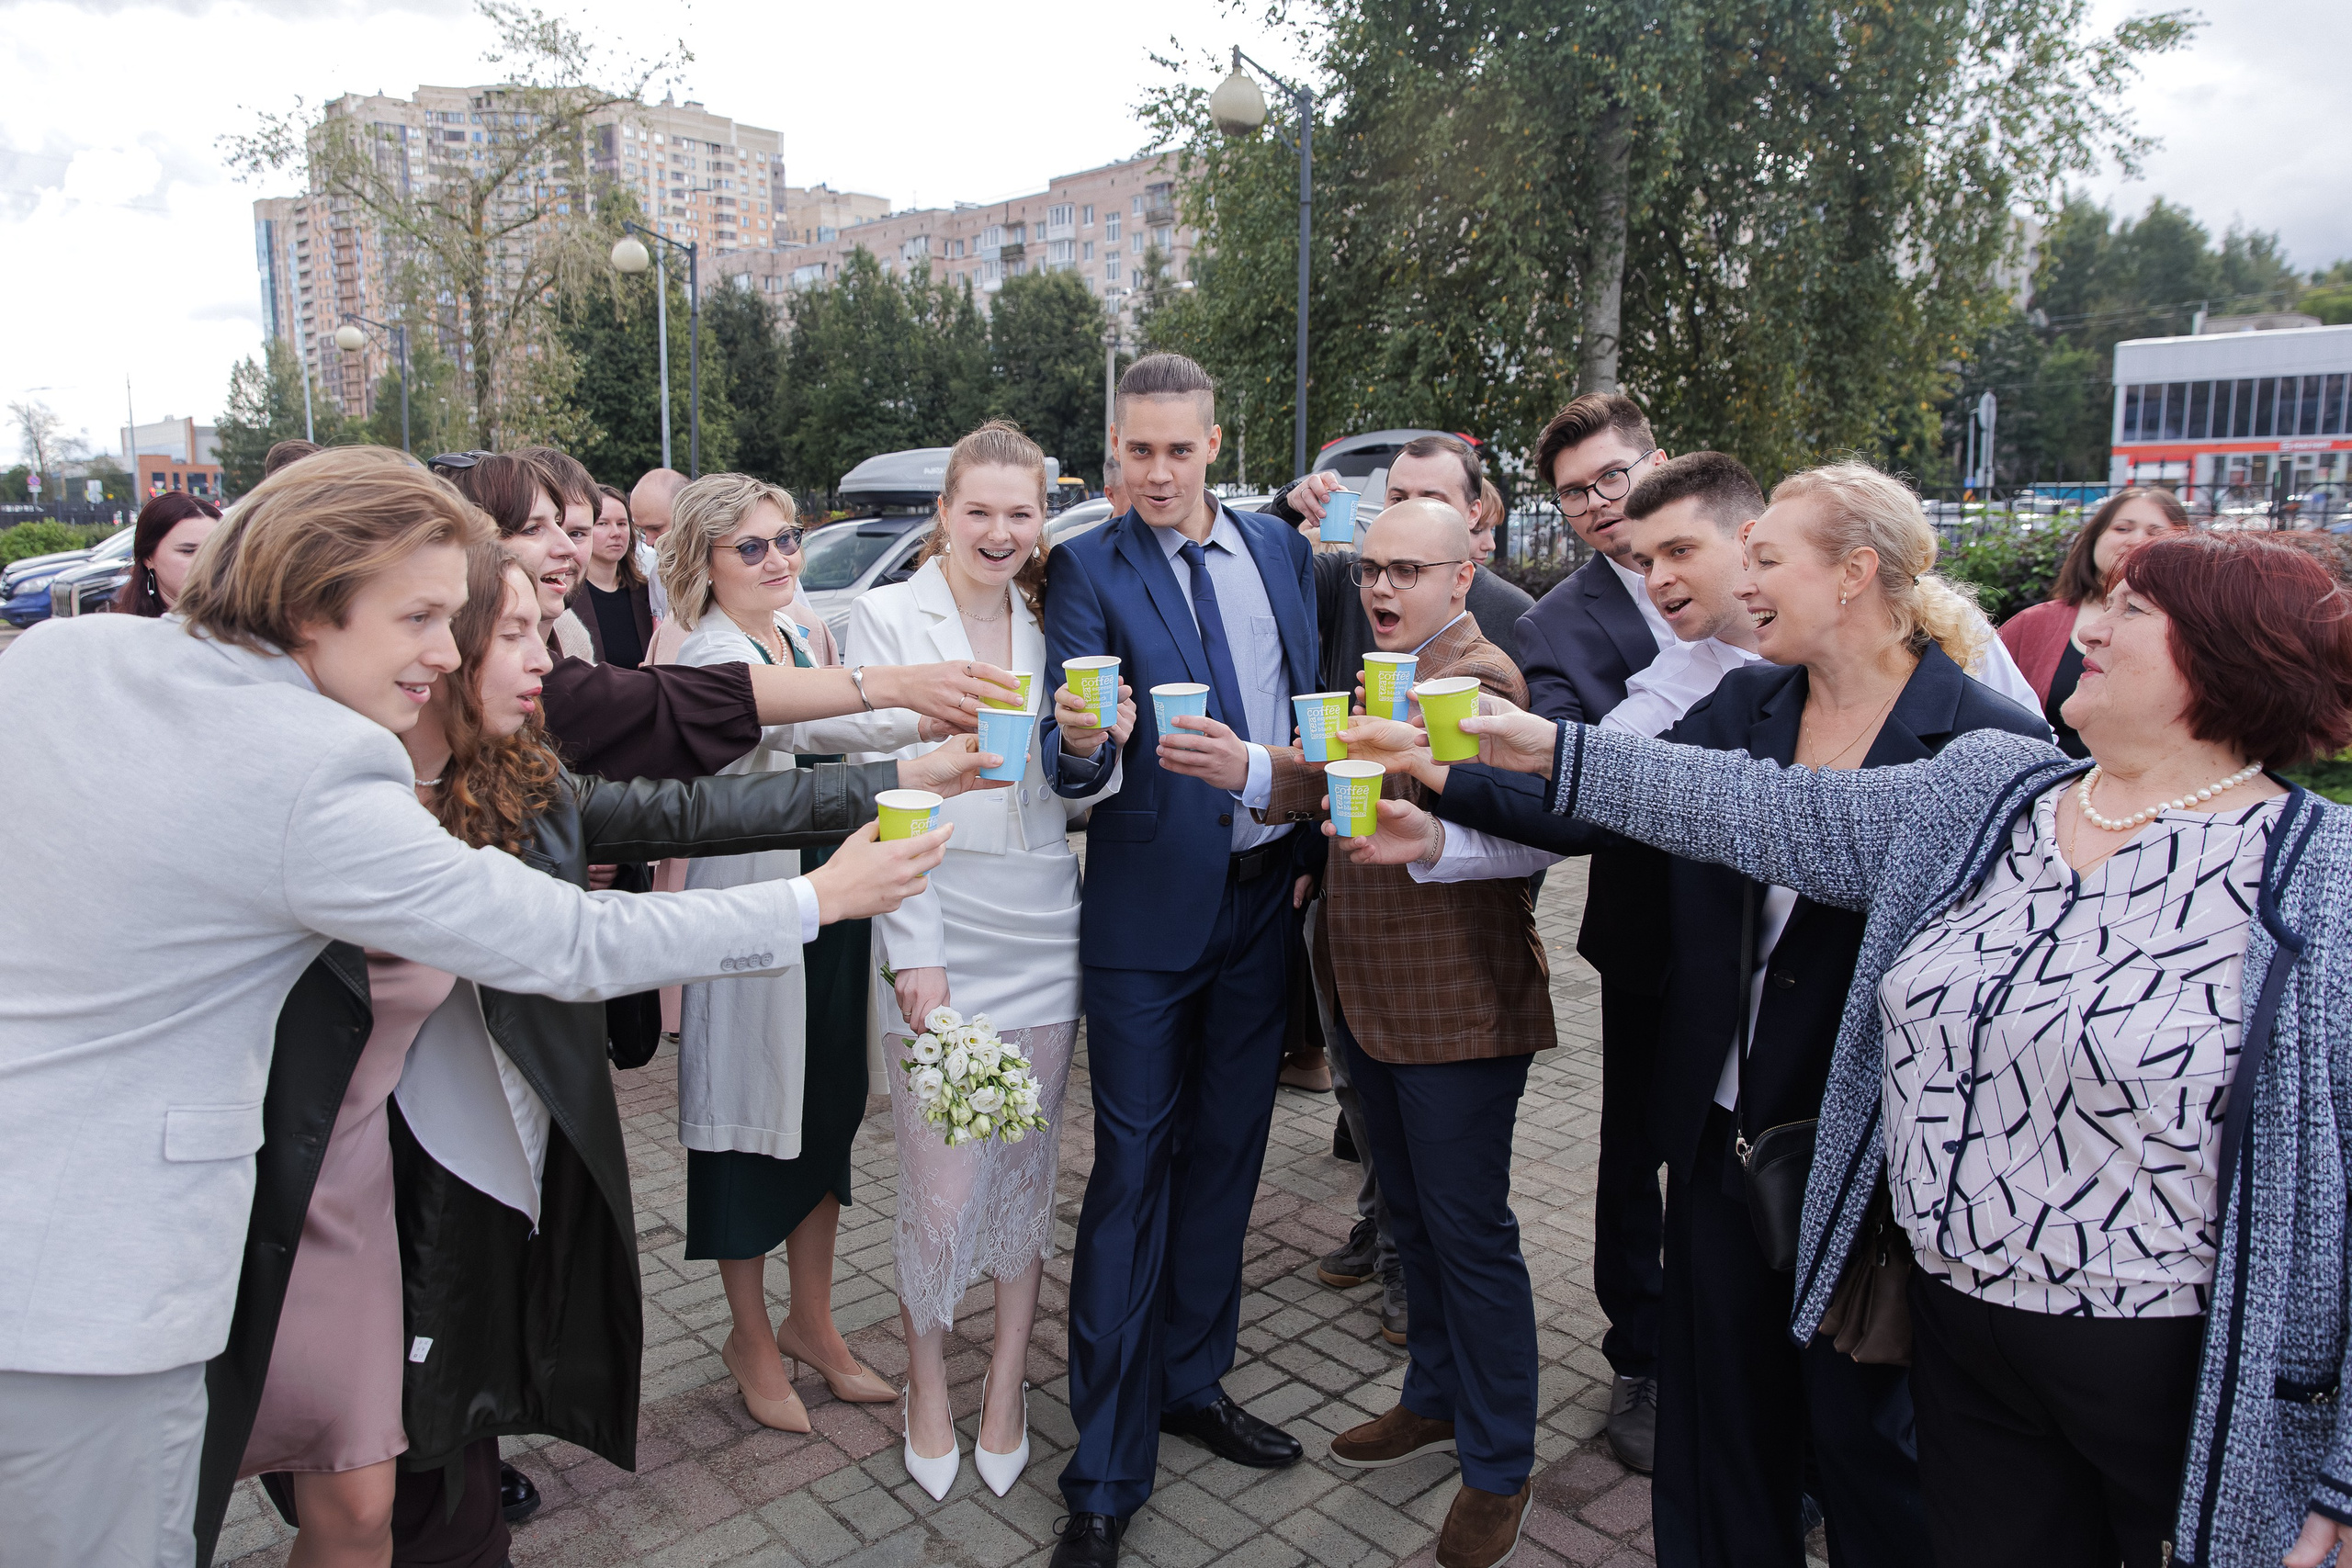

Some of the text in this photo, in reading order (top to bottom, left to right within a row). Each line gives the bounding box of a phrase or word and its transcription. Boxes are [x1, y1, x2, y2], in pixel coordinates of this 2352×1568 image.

[1081, 674, 1114, 687] coffee
[1378, 671, 1410, 681] coffee
[1379, 680, 1387, 695] tea
[1084, 687, 1092, 703] tea
[1307, 705, 1340, 716] coffee
[1309, 716, 1317, 733] tea
[1335, 784, 1369, 795] coffee
